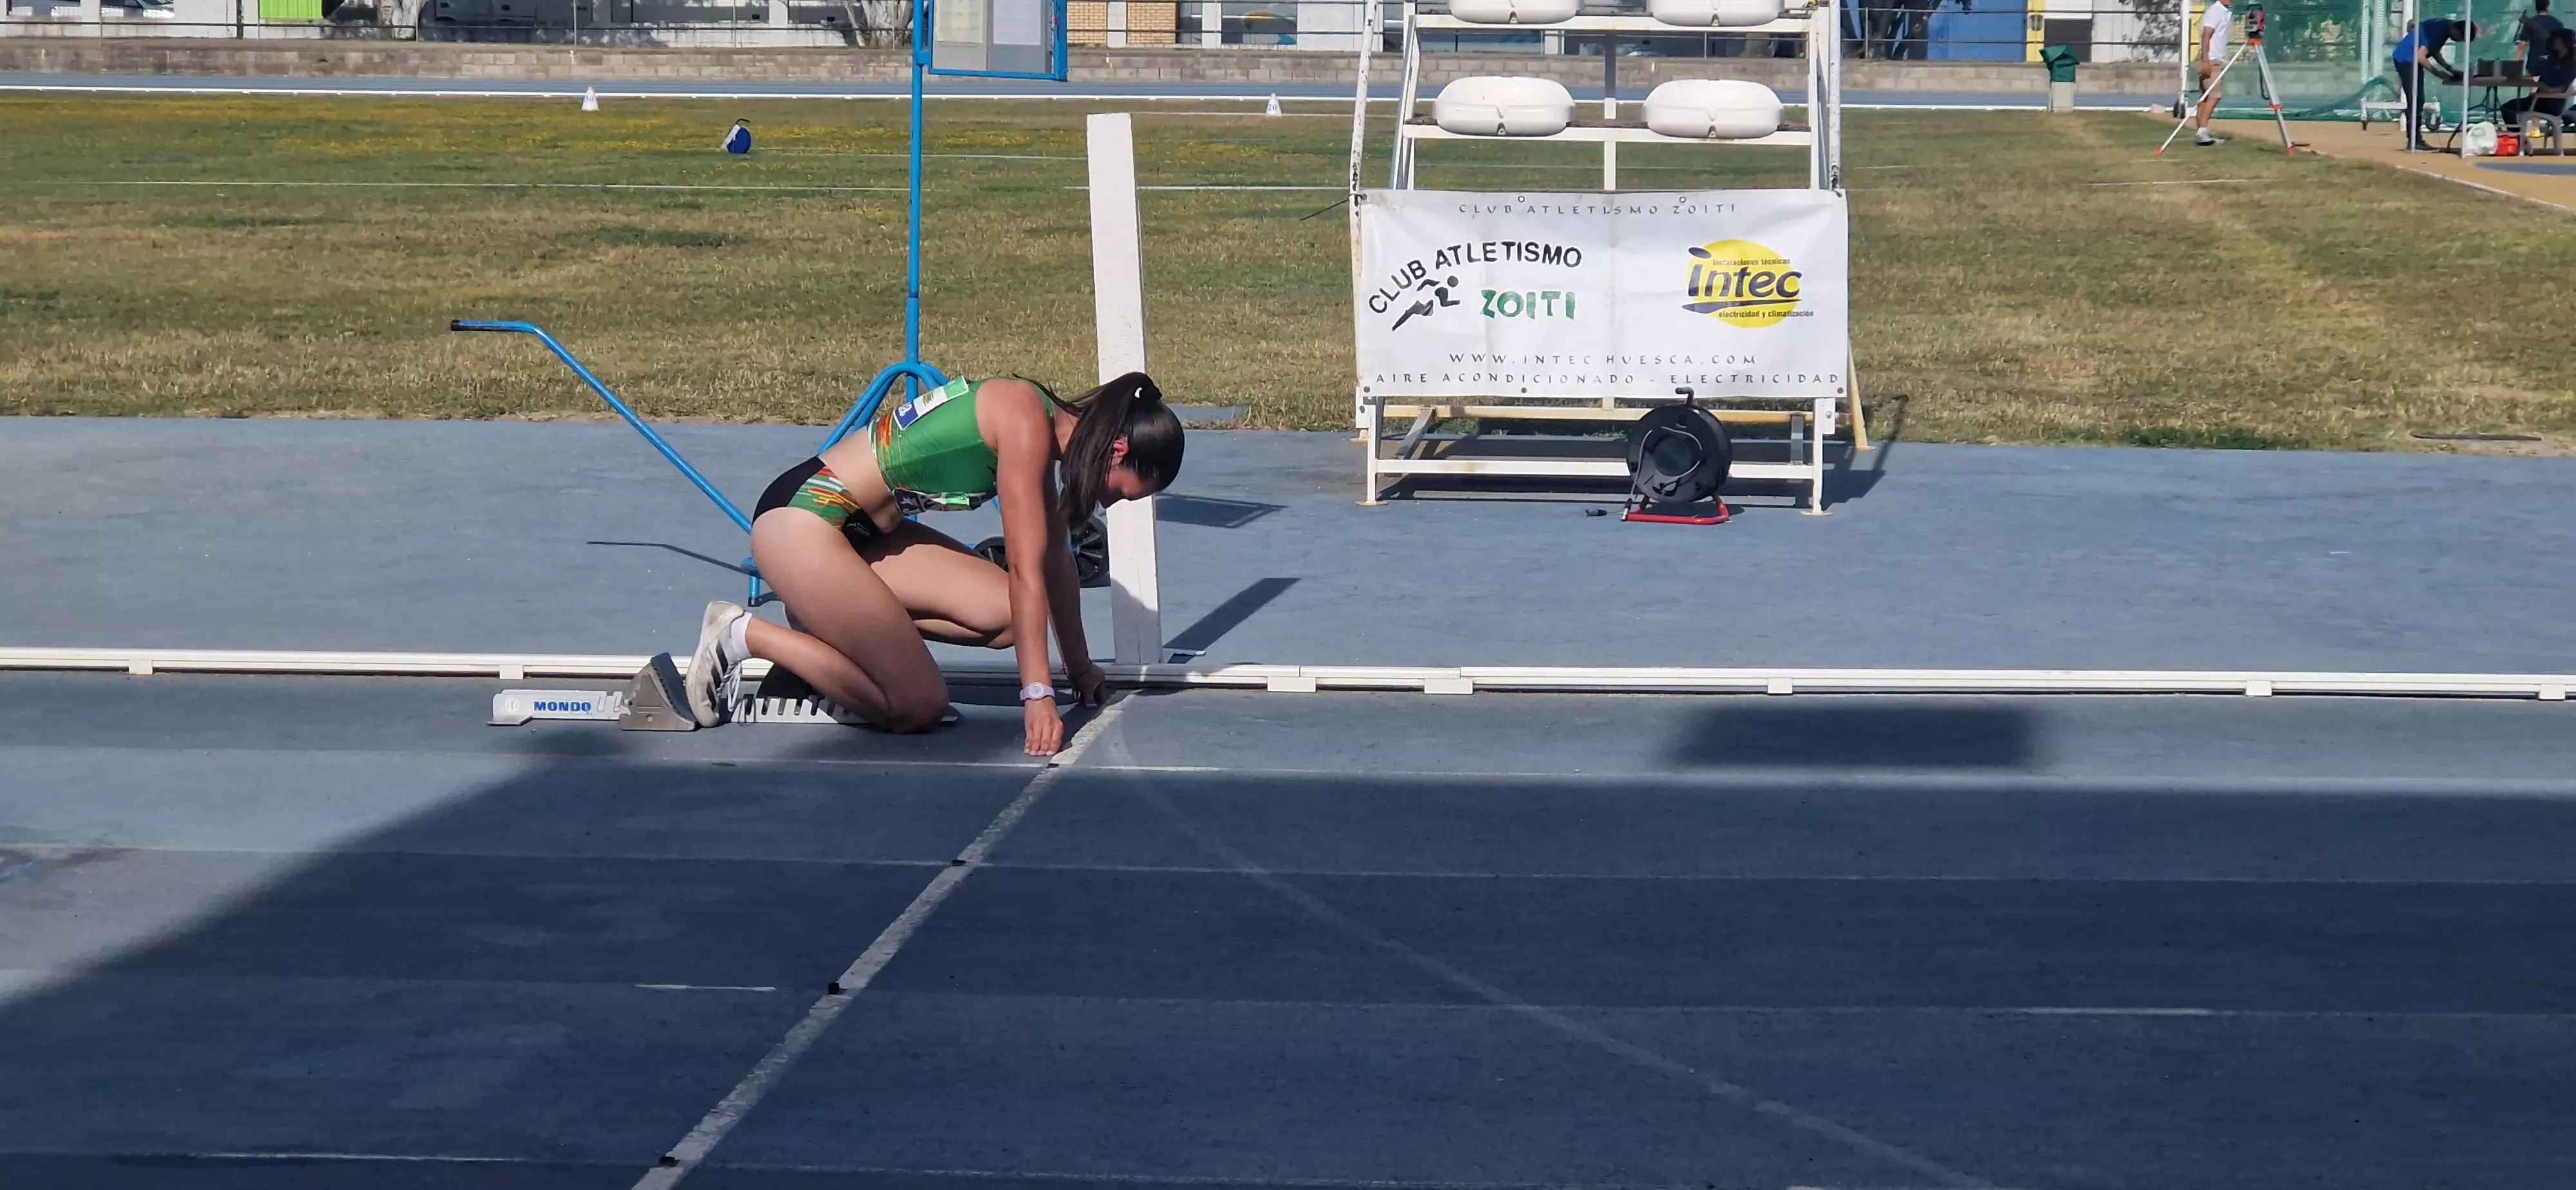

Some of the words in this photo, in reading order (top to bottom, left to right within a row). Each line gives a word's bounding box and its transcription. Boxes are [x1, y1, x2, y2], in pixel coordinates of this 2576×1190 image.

[1459, 203, 1512, 214] CLUB
[1526, 204, 1658, 214] ATLETISMO
[1673, 204, 1734, 214] ZOITI
[1368, 260, 1426, 314] CLUB
[1435, 241, 1582, 270] ATLETISMO
[1481, 289, 1576, 319] ZOITI
[1376, 373, 1427, 383] AIRE
[1442, 373, 1634, 384] ACONDICIONADO
[1670, 374, 1839, 384] ELECTRICIDAD
[534, 701, 591, 712] MONDO
